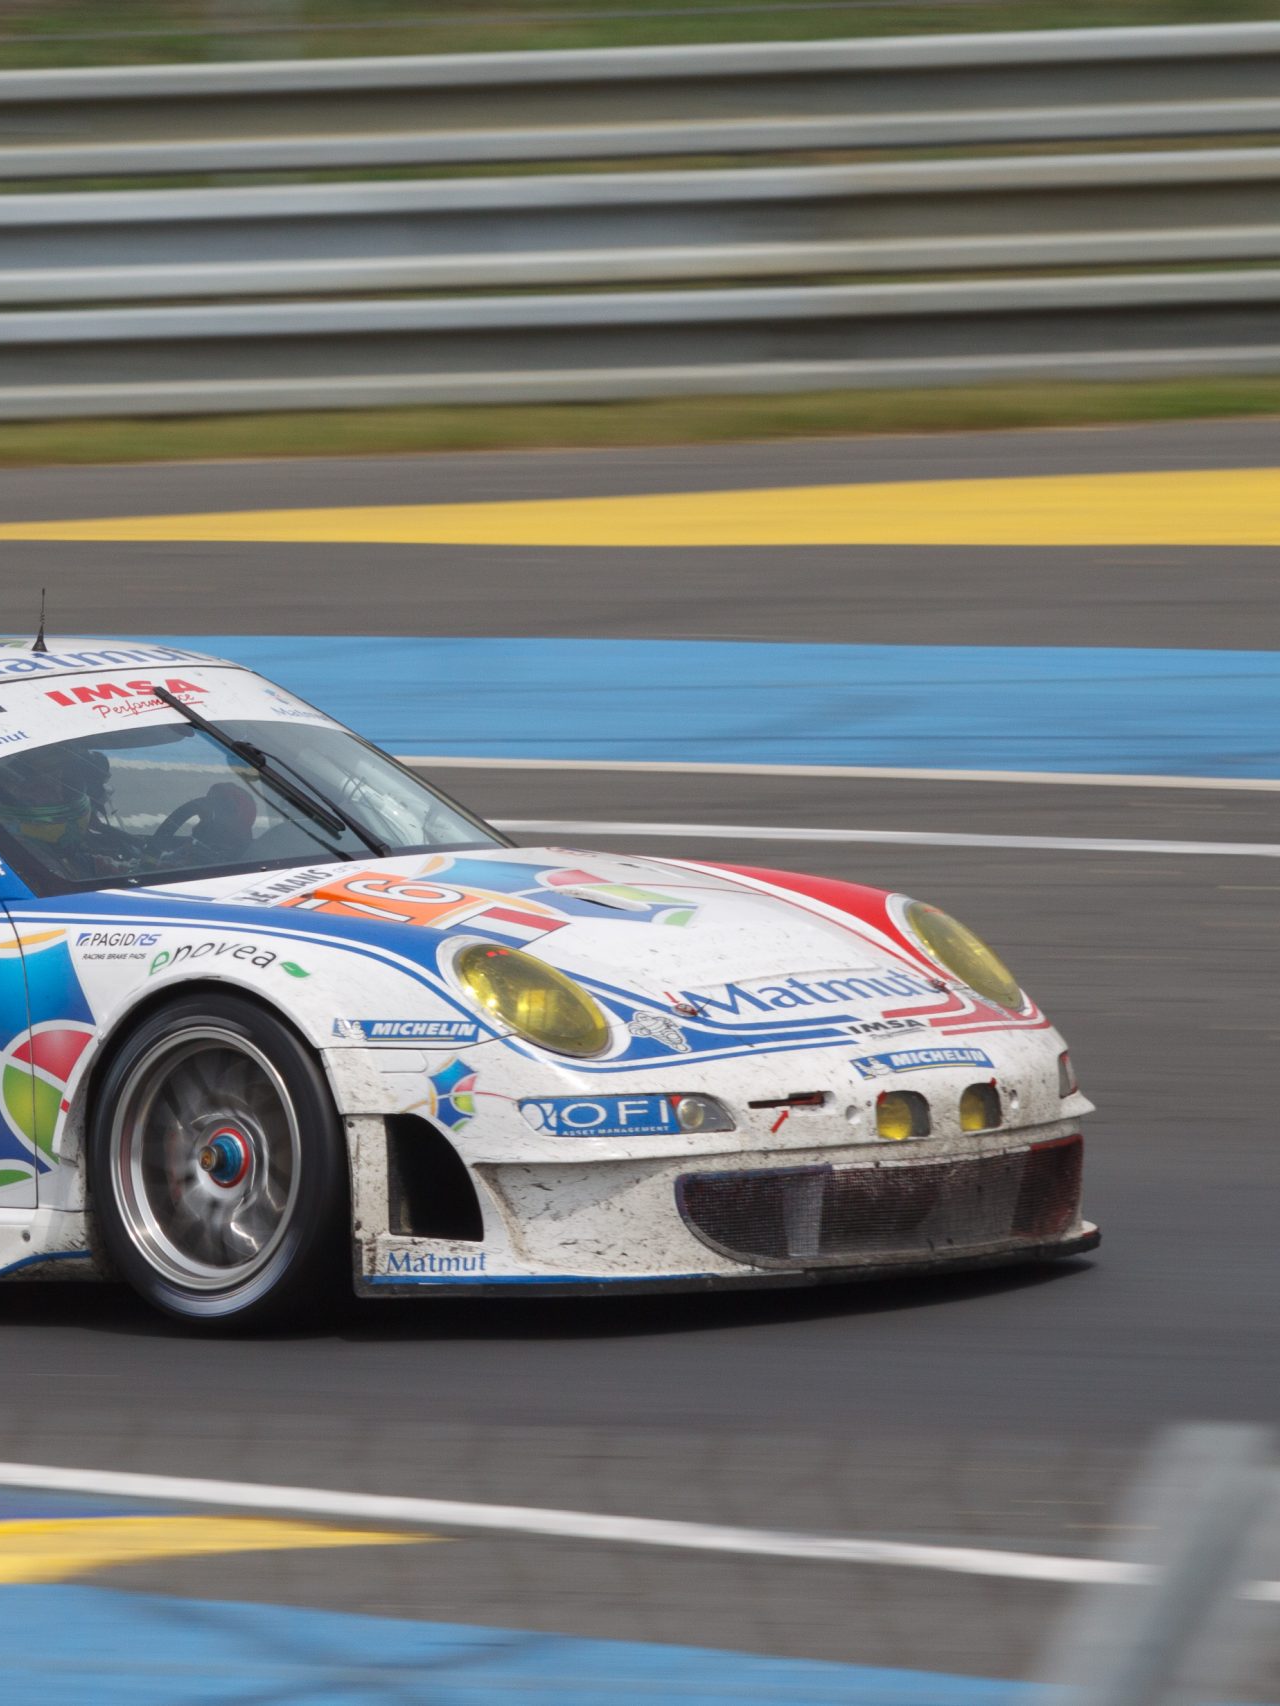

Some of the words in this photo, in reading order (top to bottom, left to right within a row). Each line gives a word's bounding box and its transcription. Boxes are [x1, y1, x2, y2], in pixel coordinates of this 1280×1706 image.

[44, 679, 208, 707] IMSA
[92, 694, 195, 719] Performce
[267, 869, 332, 894] MANS
[149, 942, 277, 976] enovea
[678, 969, 941, 1017] Matmut
[371, 1022, 477, 1036] MICHELIN
[848, 1019, 926, 1035] IMSA
[890, 1050, 986, 1067] MICHELIN
[561, 1100, 669, 1127] OFI
[598, 1126, 669, 1134] MANAGEMENT
[387, 1252, 488, 1273] Matmut
